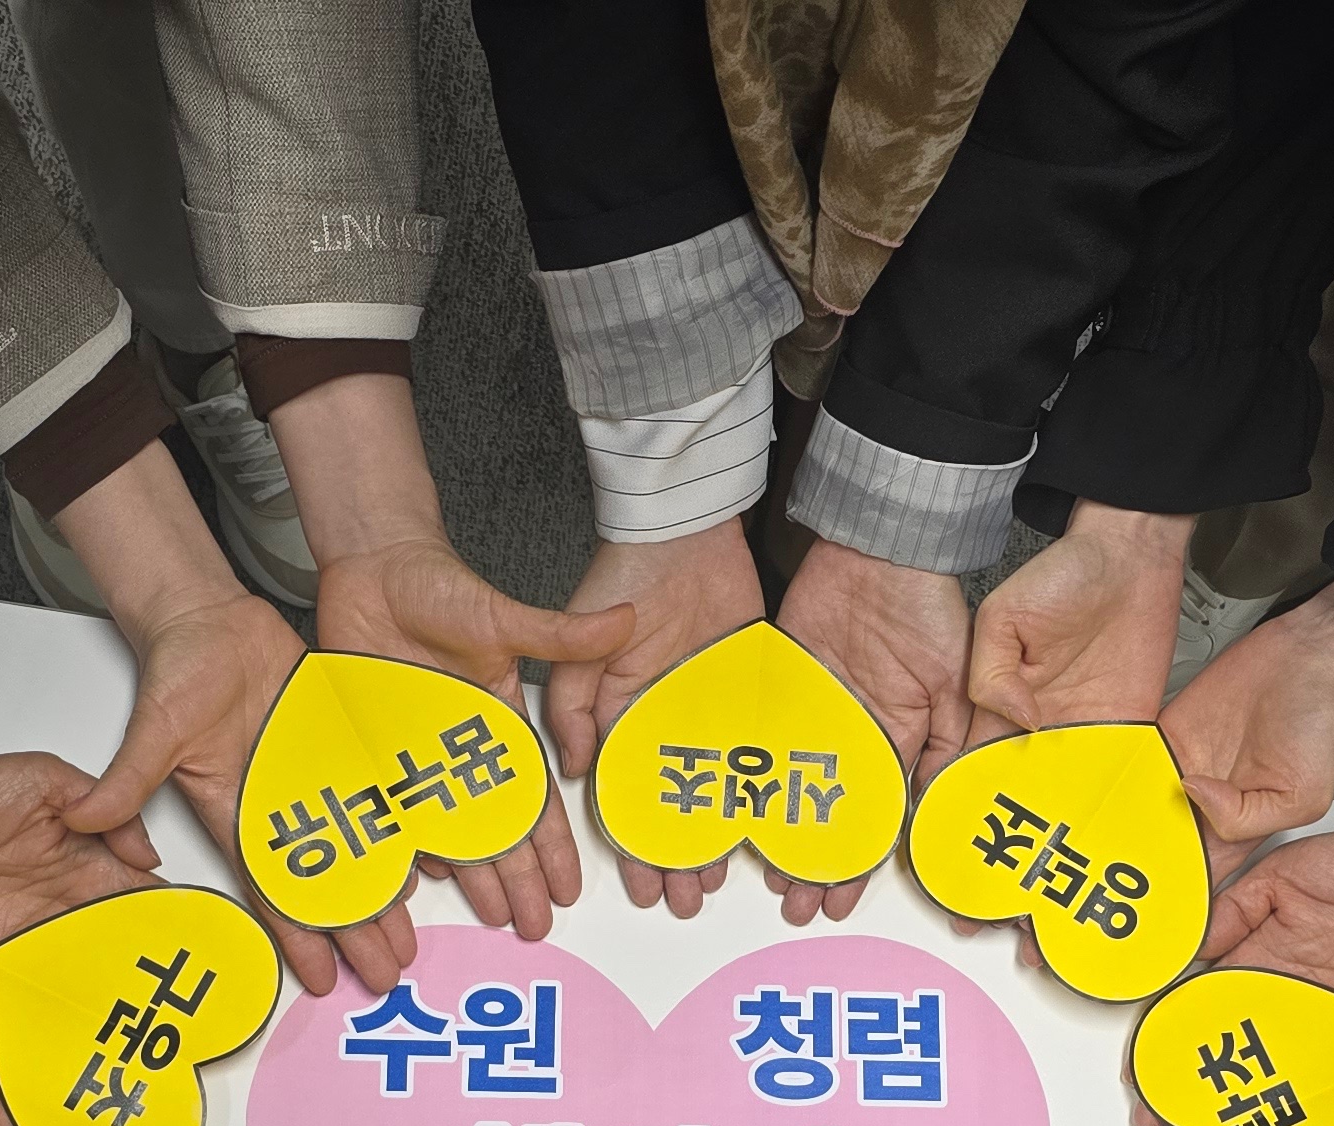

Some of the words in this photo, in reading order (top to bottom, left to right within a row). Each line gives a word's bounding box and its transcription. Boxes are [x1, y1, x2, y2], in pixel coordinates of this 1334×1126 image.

[267, 713, 516, 878] 꿈누리유
[659, 744, 845, 824] 신성초
[971, 793, 1150, 940] 영덕초
[345, 985, 557, 1093] 수원
[736, 990, 943, 1101] 청렴
